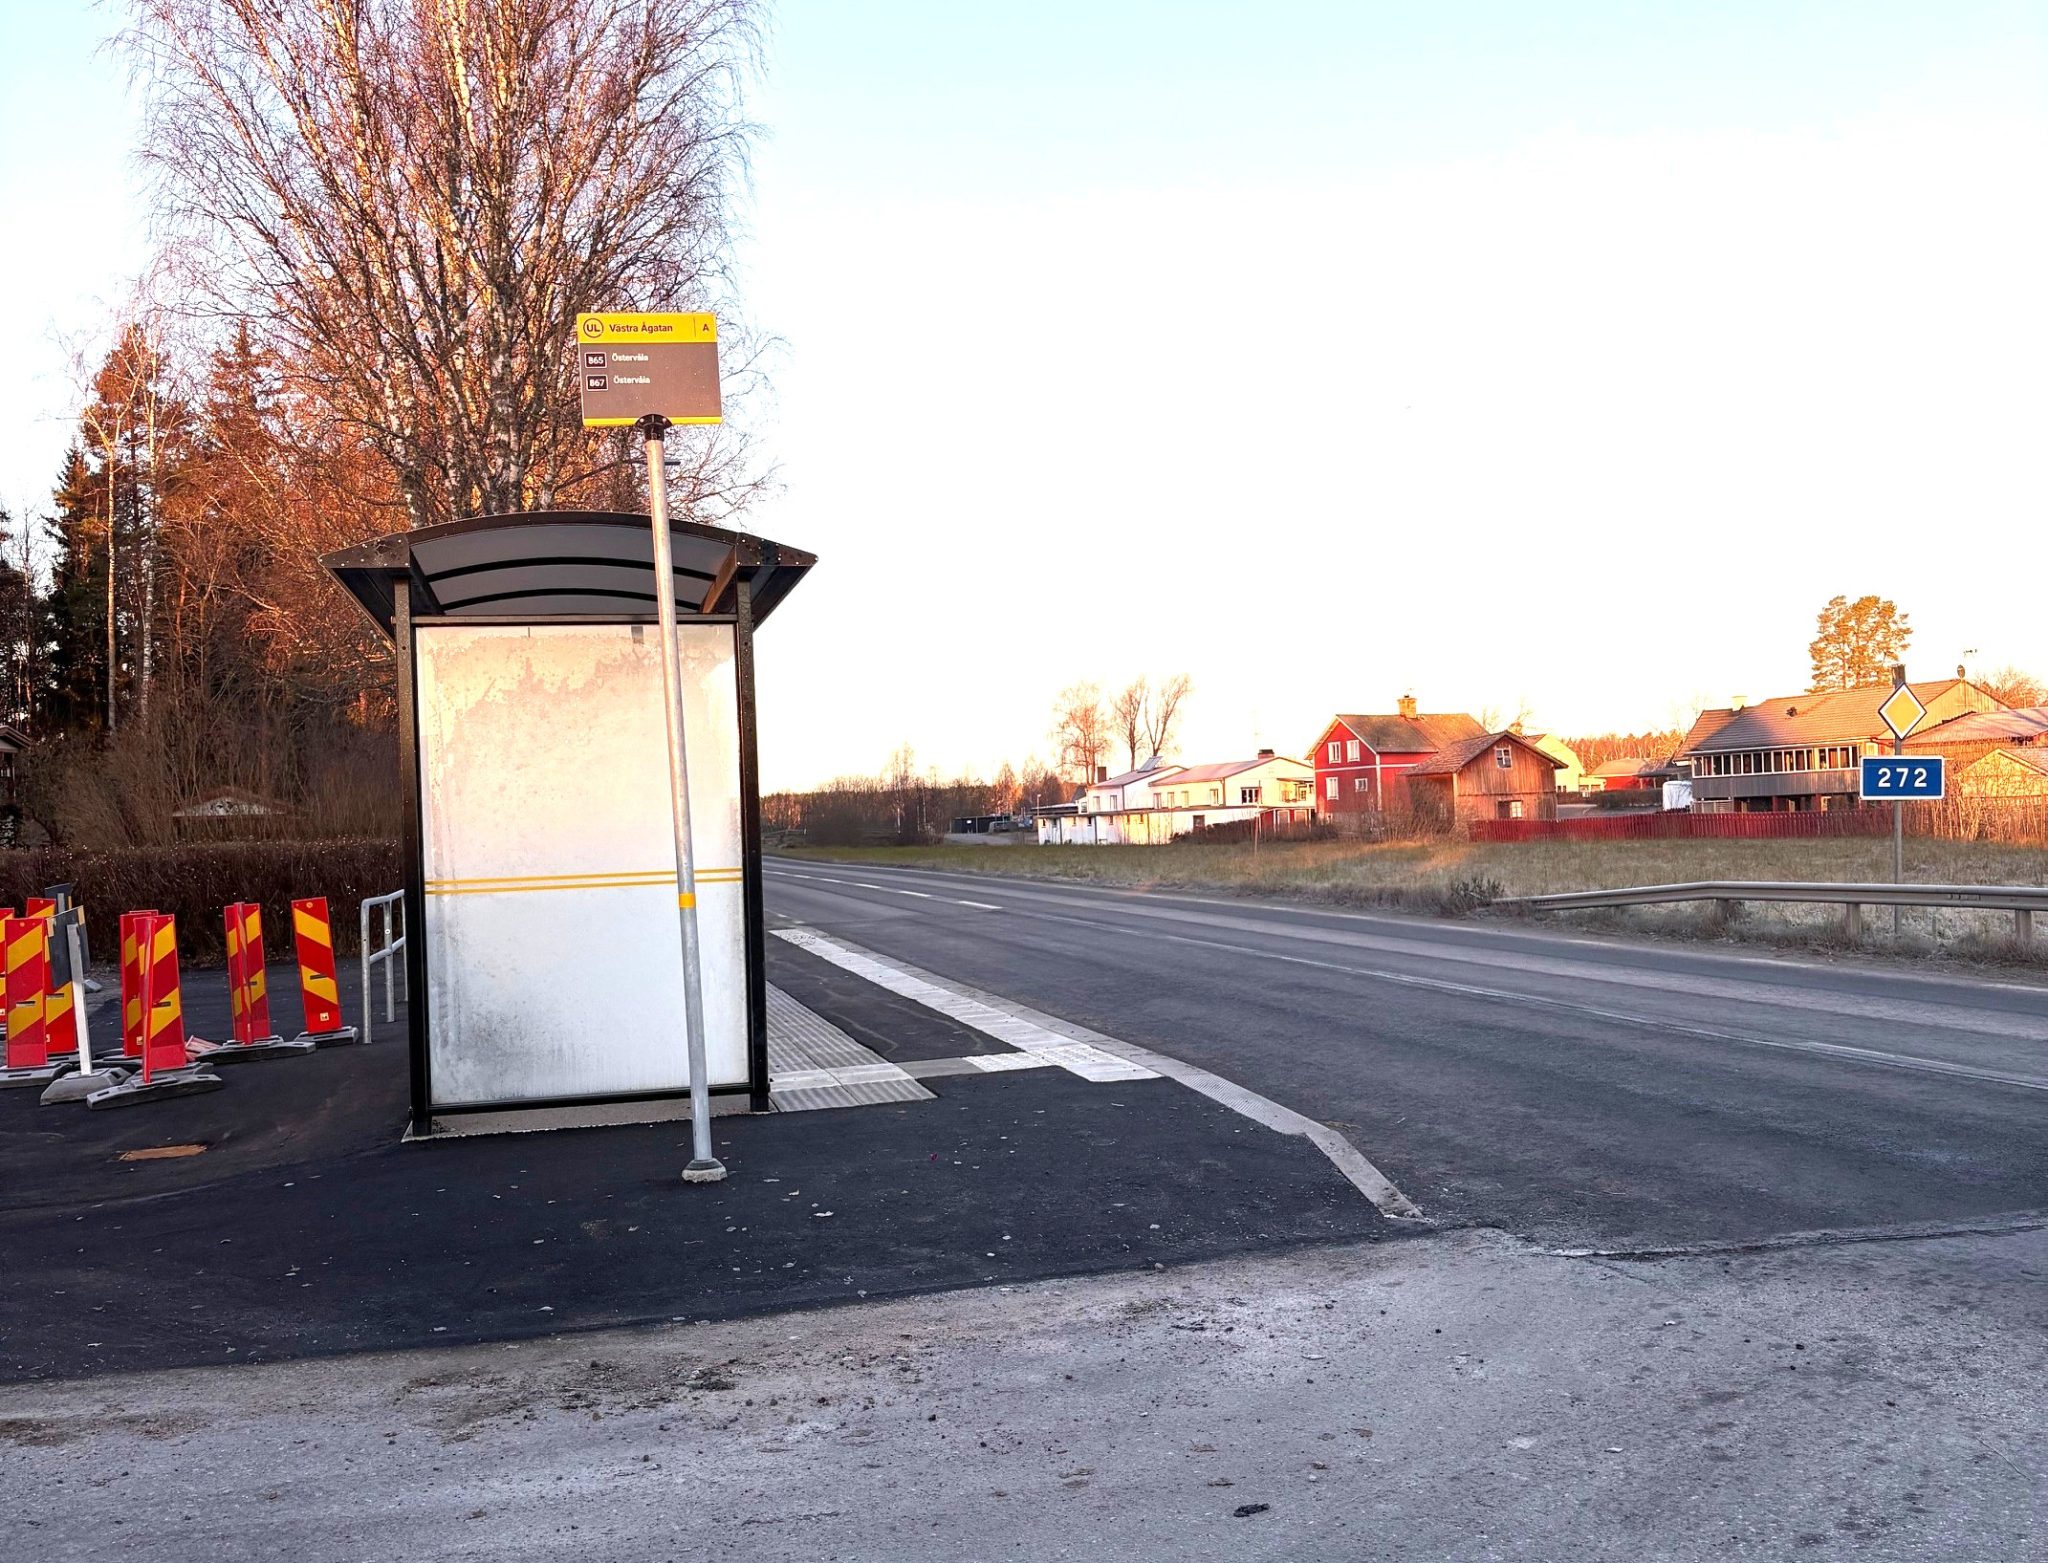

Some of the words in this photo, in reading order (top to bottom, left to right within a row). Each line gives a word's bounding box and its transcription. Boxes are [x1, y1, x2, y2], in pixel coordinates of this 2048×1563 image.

[586, 324, 600, 333] UL
[609, 324, 639, 333] Västra
[641, 322, 673, 334] Ågatan
[702, 323, 710, 332] A
[611, 352, 649, 362] Östervåla
[613, 374, 651, 384] Östervåla
[1878, 767, 1928, 788] 272
